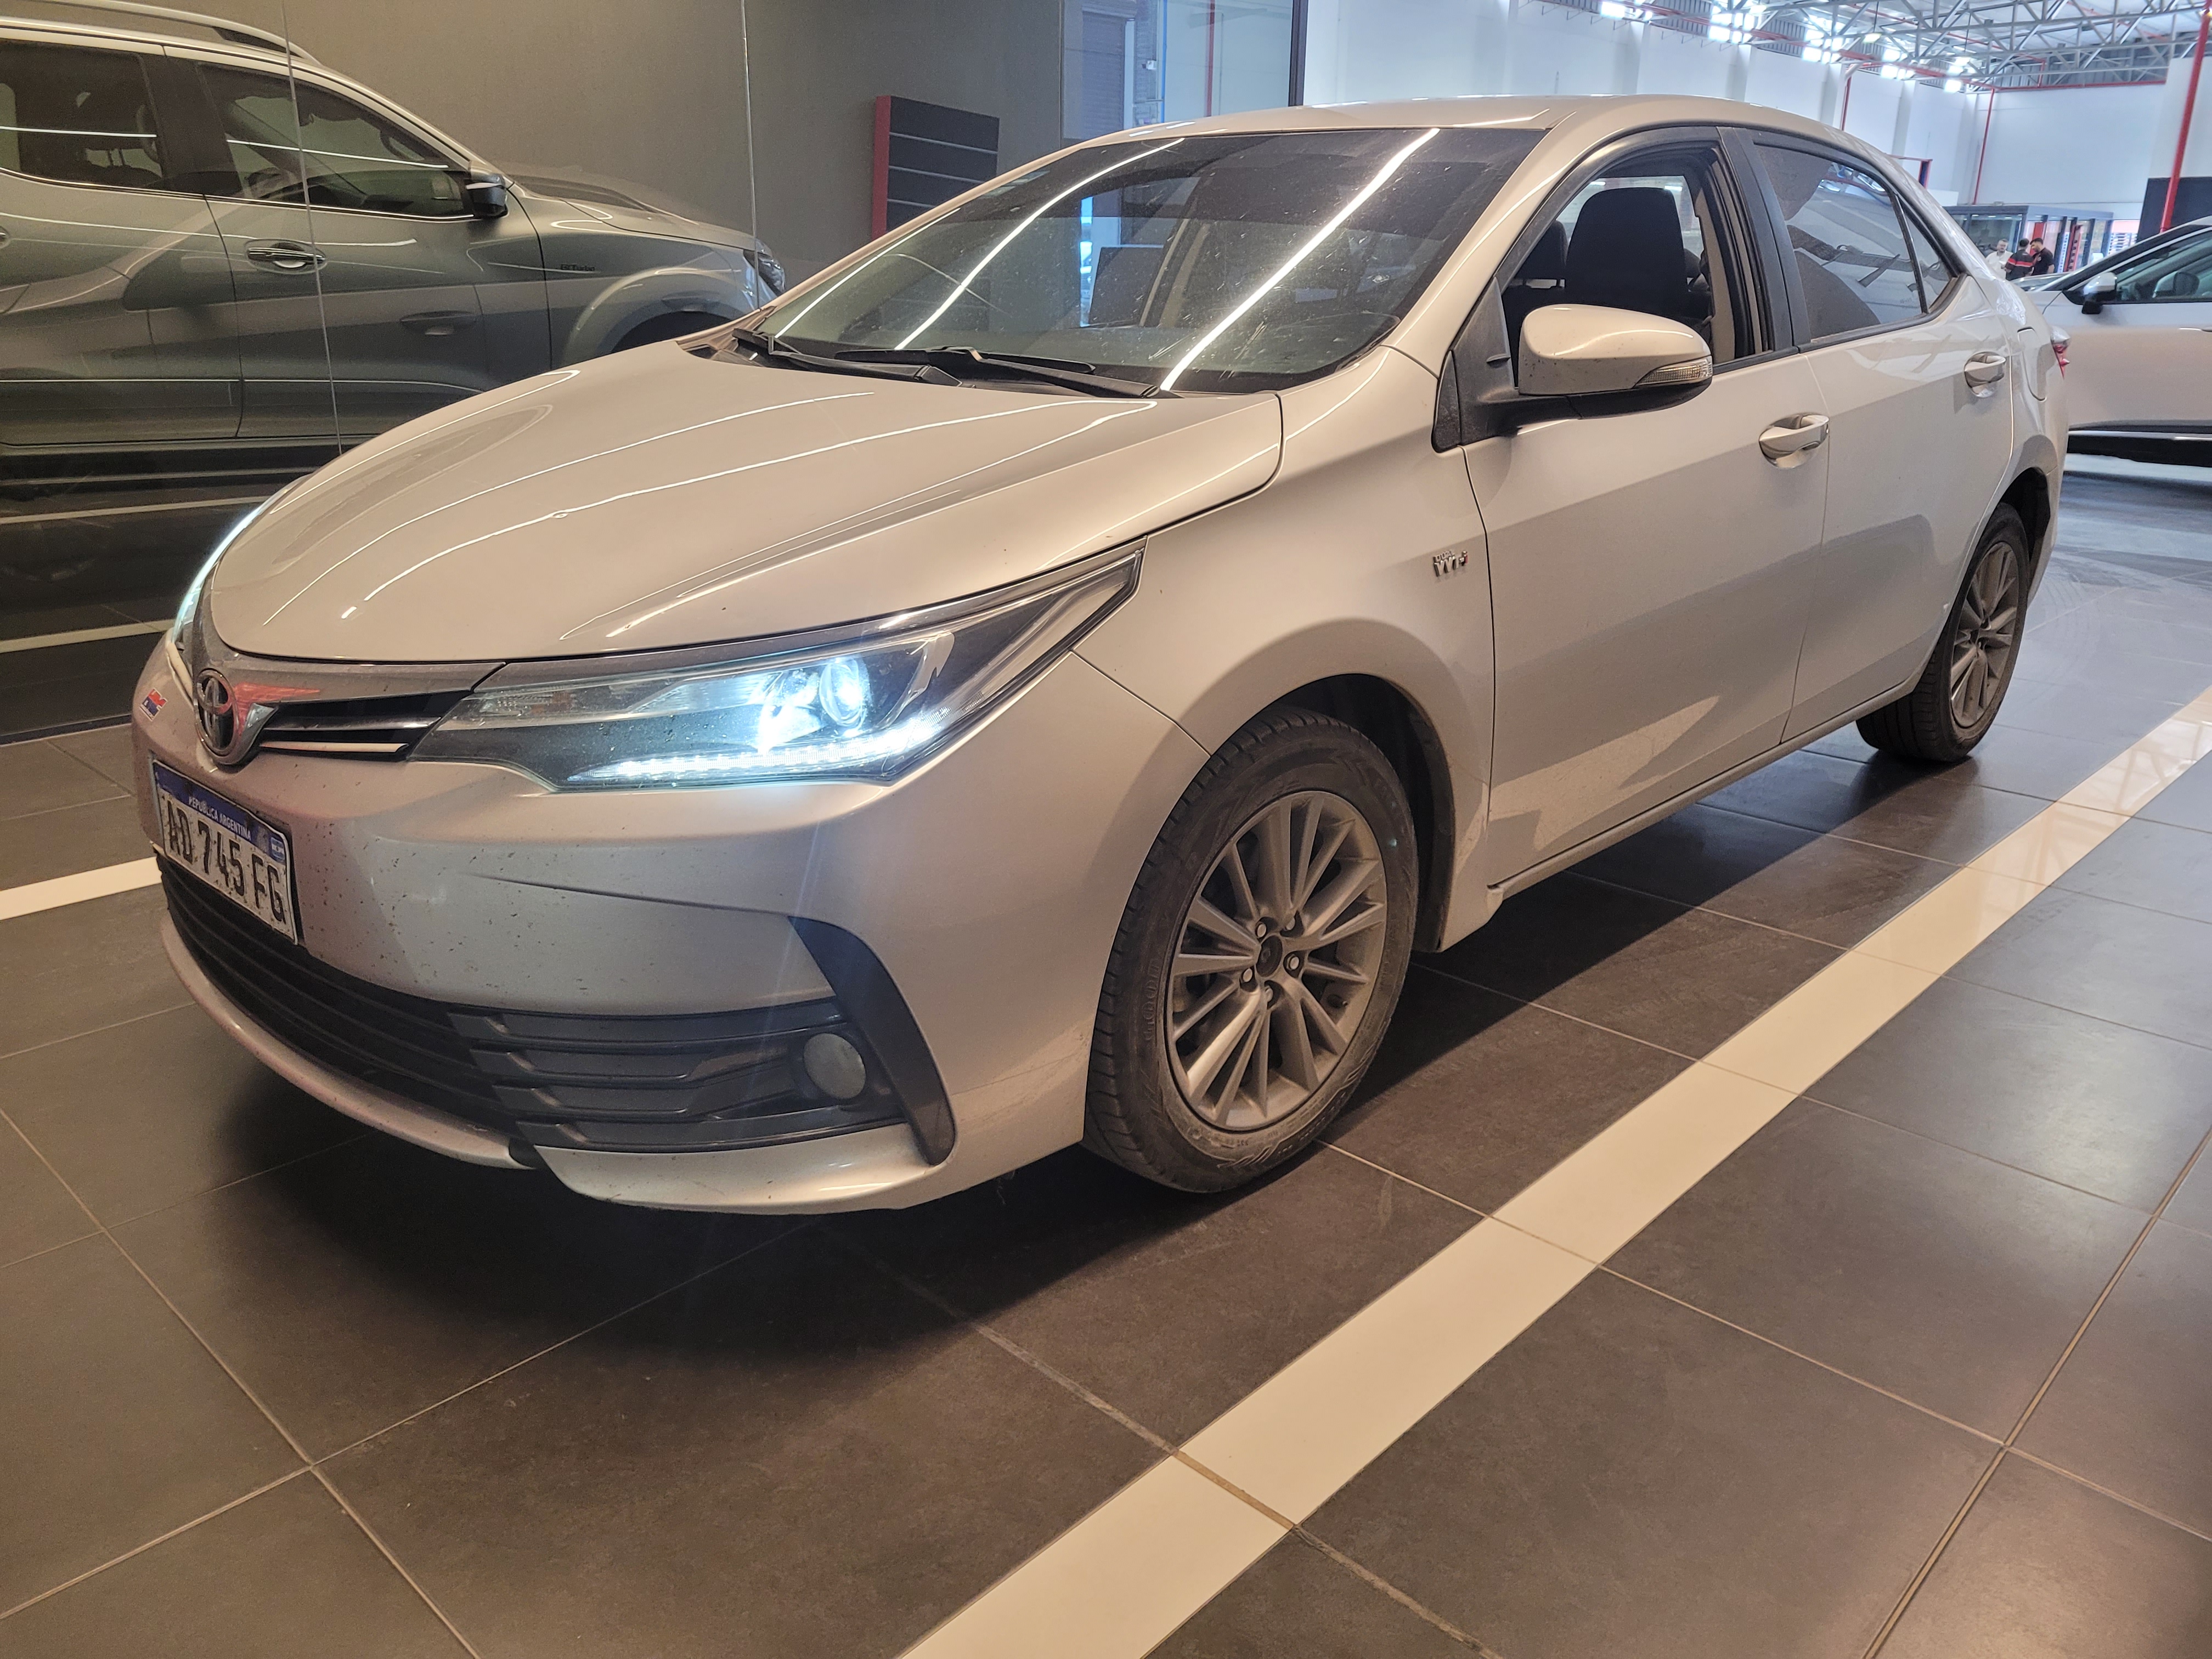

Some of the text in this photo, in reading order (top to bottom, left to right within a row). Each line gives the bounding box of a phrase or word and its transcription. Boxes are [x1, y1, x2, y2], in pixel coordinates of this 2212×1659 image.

[167, 799, 286, 924] AD 745 FG
[220, 813, 251, 841] ARGENTINA
